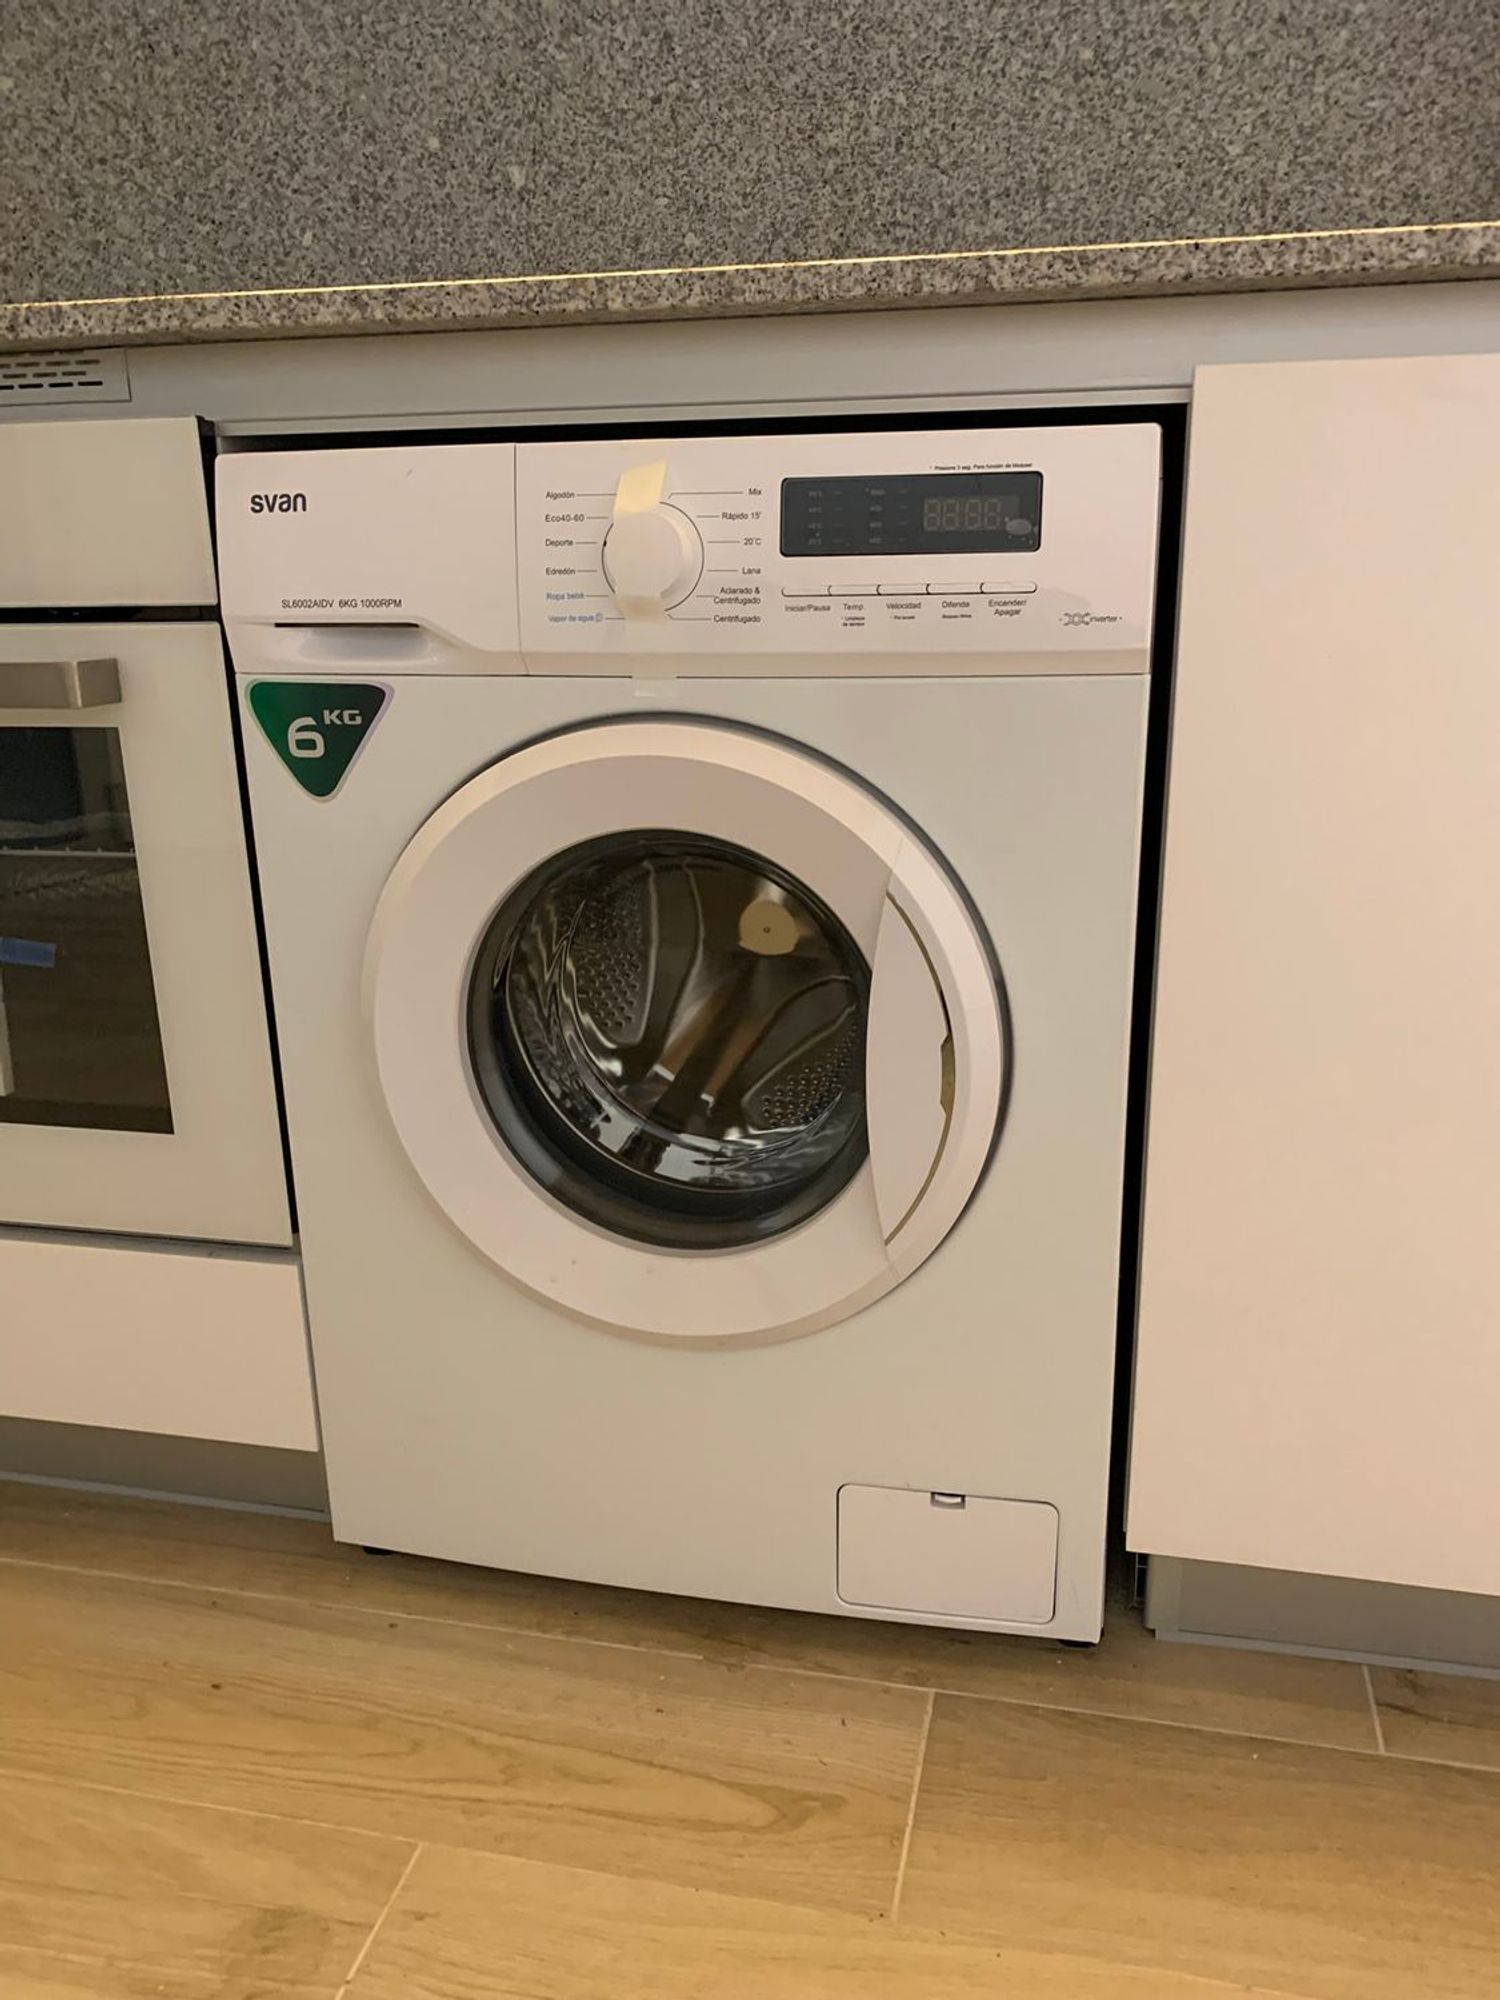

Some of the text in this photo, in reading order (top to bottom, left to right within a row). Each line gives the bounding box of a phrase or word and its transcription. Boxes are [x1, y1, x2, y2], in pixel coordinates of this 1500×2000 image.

[545, 490, 576, 501] Algodón
[748, 487, 762, 496] Mix
[250, 493, 307, 513] svan
[545, 513, 585, 523] Eco40-60
[721, 512, 749, 521] Rápido
[545, 538, 574, 548] Deporte
[545, 566, 576, 576] Edredón
[742, 566, 761, 575] Lana
[720, 586, 761, 595] Aclarado &
[281, 598, 402, 609] SL6002AIDV 6KG 1000RPM
[713, 596, 762, 606] Centrifugado
[886, 601, 922, 610] Velocidad
[994, 608, 1022, 617] Apagar
[713, 614, 762, 624] Centrifugado
[323, 708, 362, 726] KG
[287, 717, 325, 758] 6
